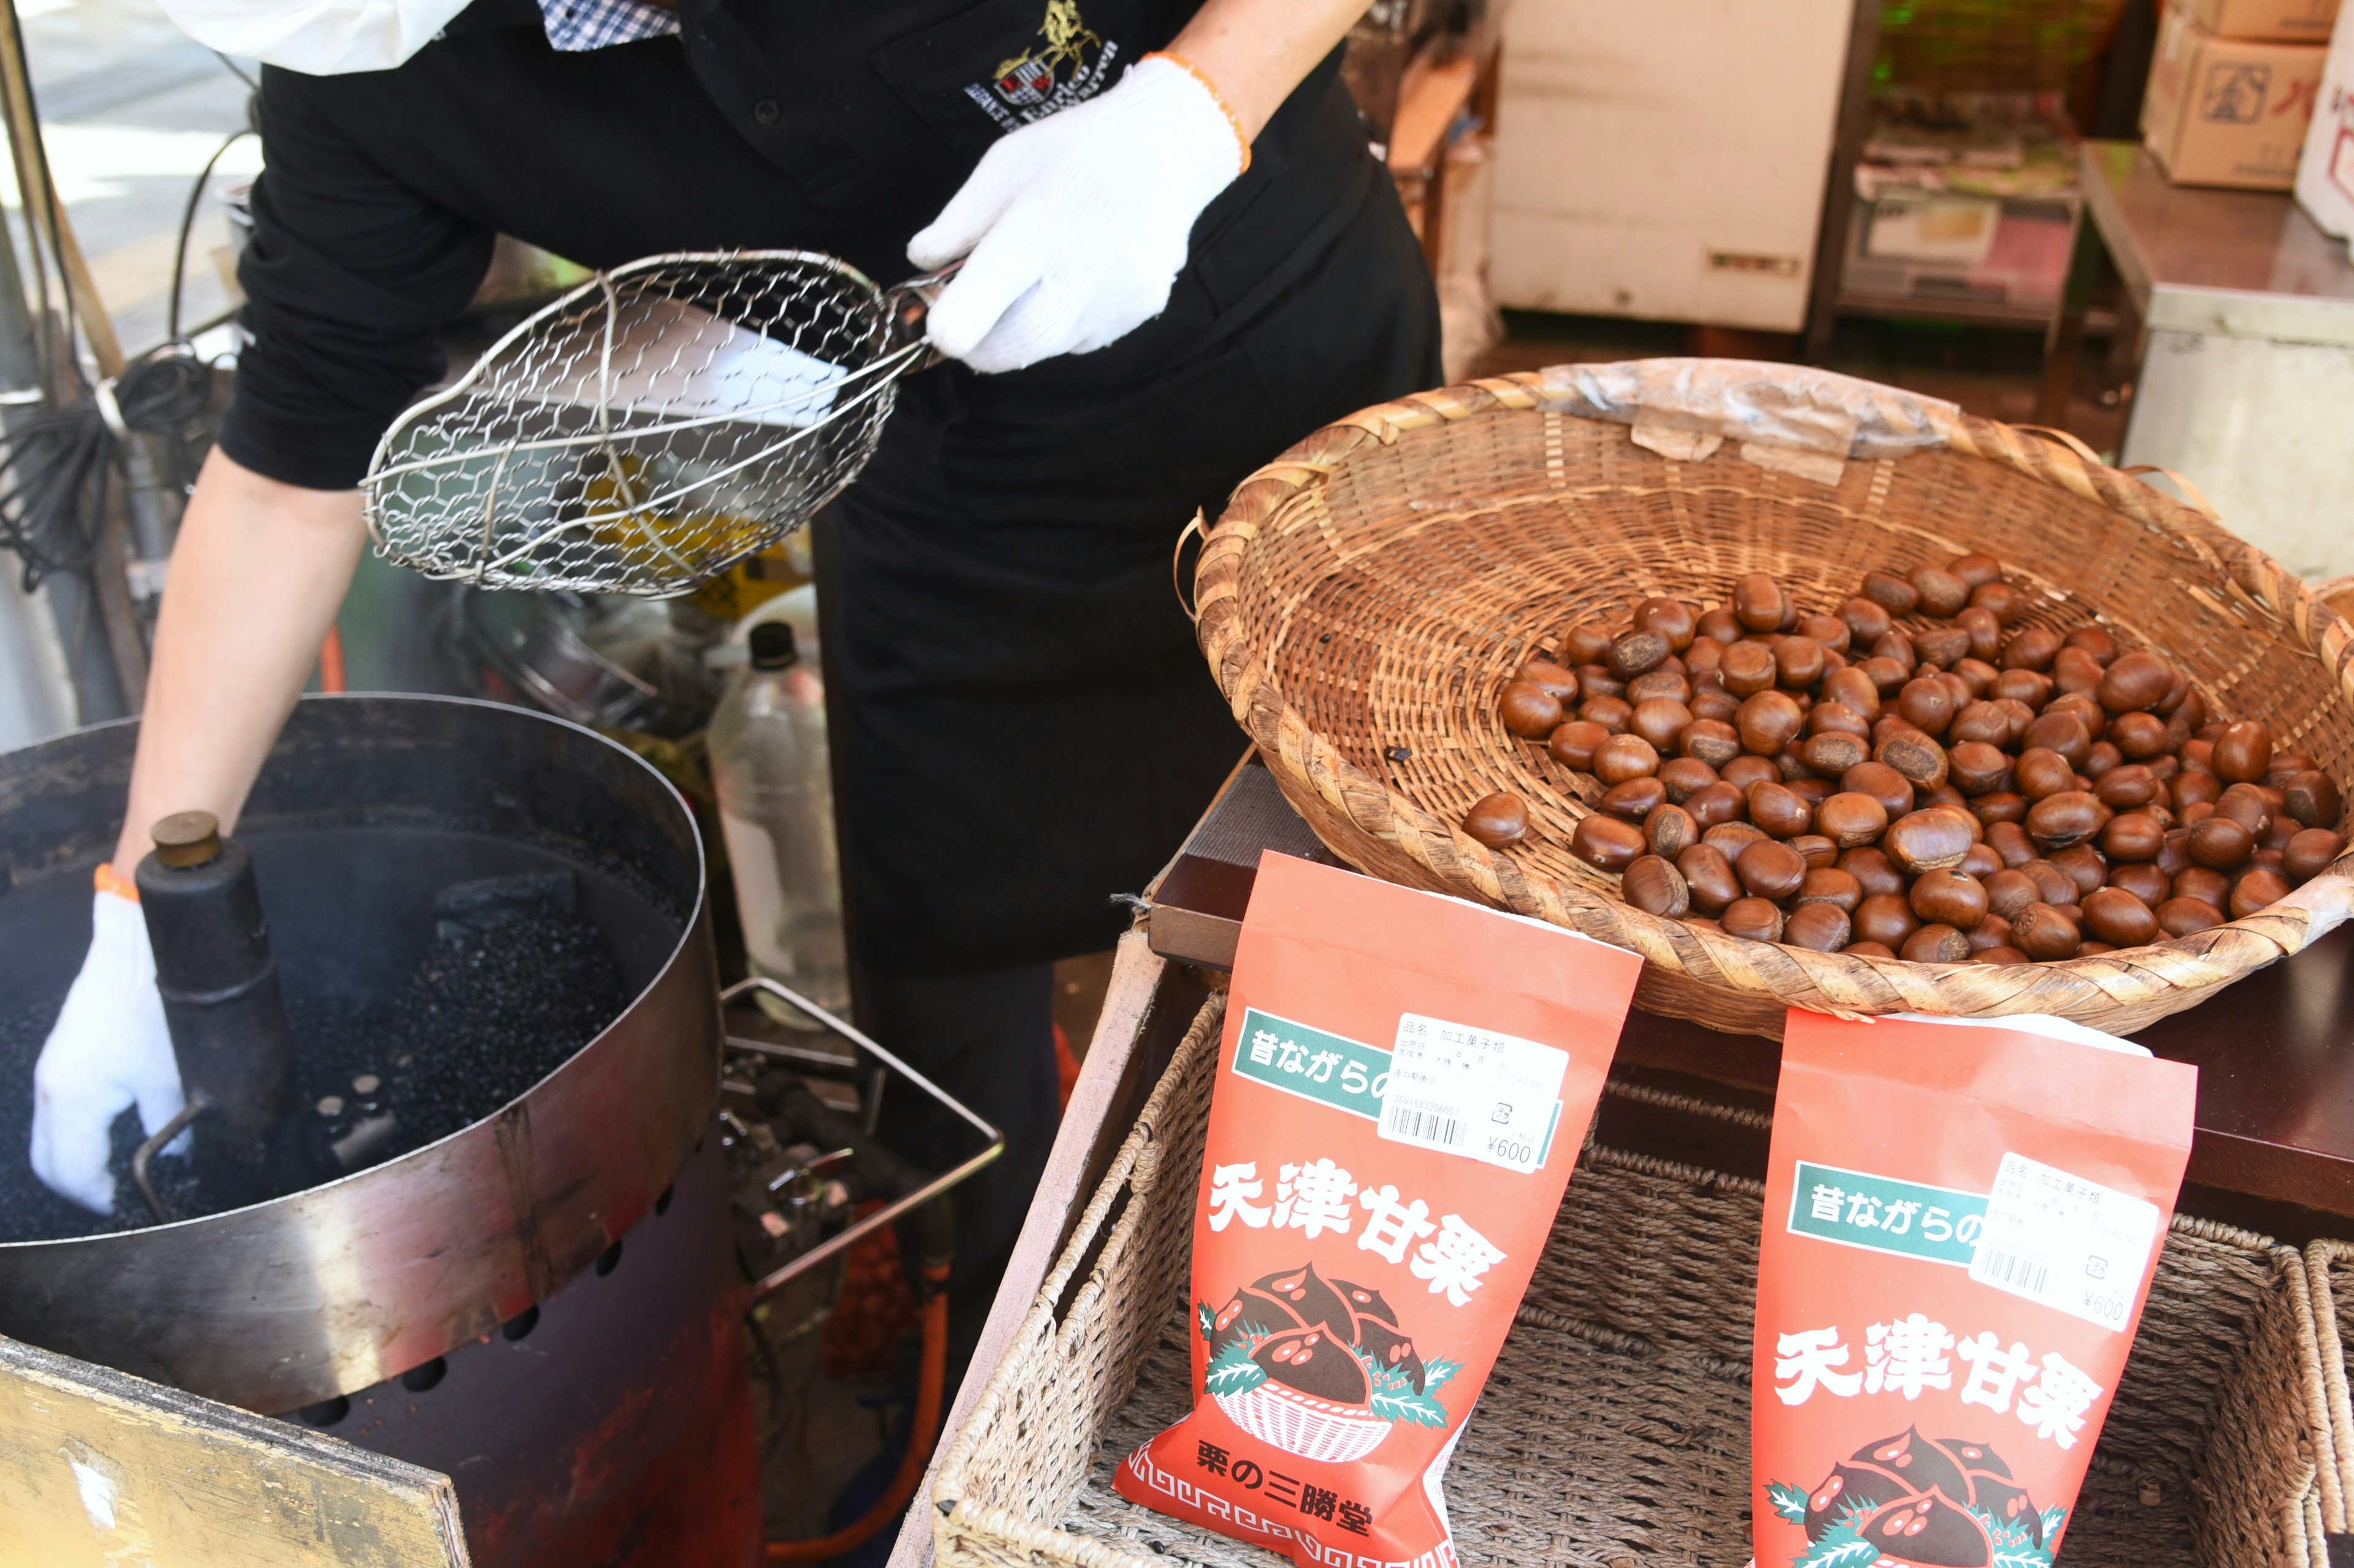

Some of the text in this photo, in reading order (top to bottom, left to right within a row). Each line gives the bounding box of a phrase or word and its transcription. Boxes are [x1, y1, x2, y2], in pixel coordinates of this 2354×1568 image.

[1403, 1021, 1506, 1054] 品名 加工菓子類
[1393, 1094, 1460, 1117] 2091883206007
[1487, 1135, 1531, 1163] ¥600
[2005, 1160, 2028, 1179] 品名
[2038, 1173, 2101, 1206] 加工菓子類
[1208, 1157, 1507, 1307] 天津甘栗
[1811, 1184, 1986, 1247] 昔ながらの
[2083, 1290, 2124, 1321] ¥600
[1774, 1312, 2104, 1450] 天津甘栗
[1197, 1439, 1373, 1537] 栗の三勝堂
